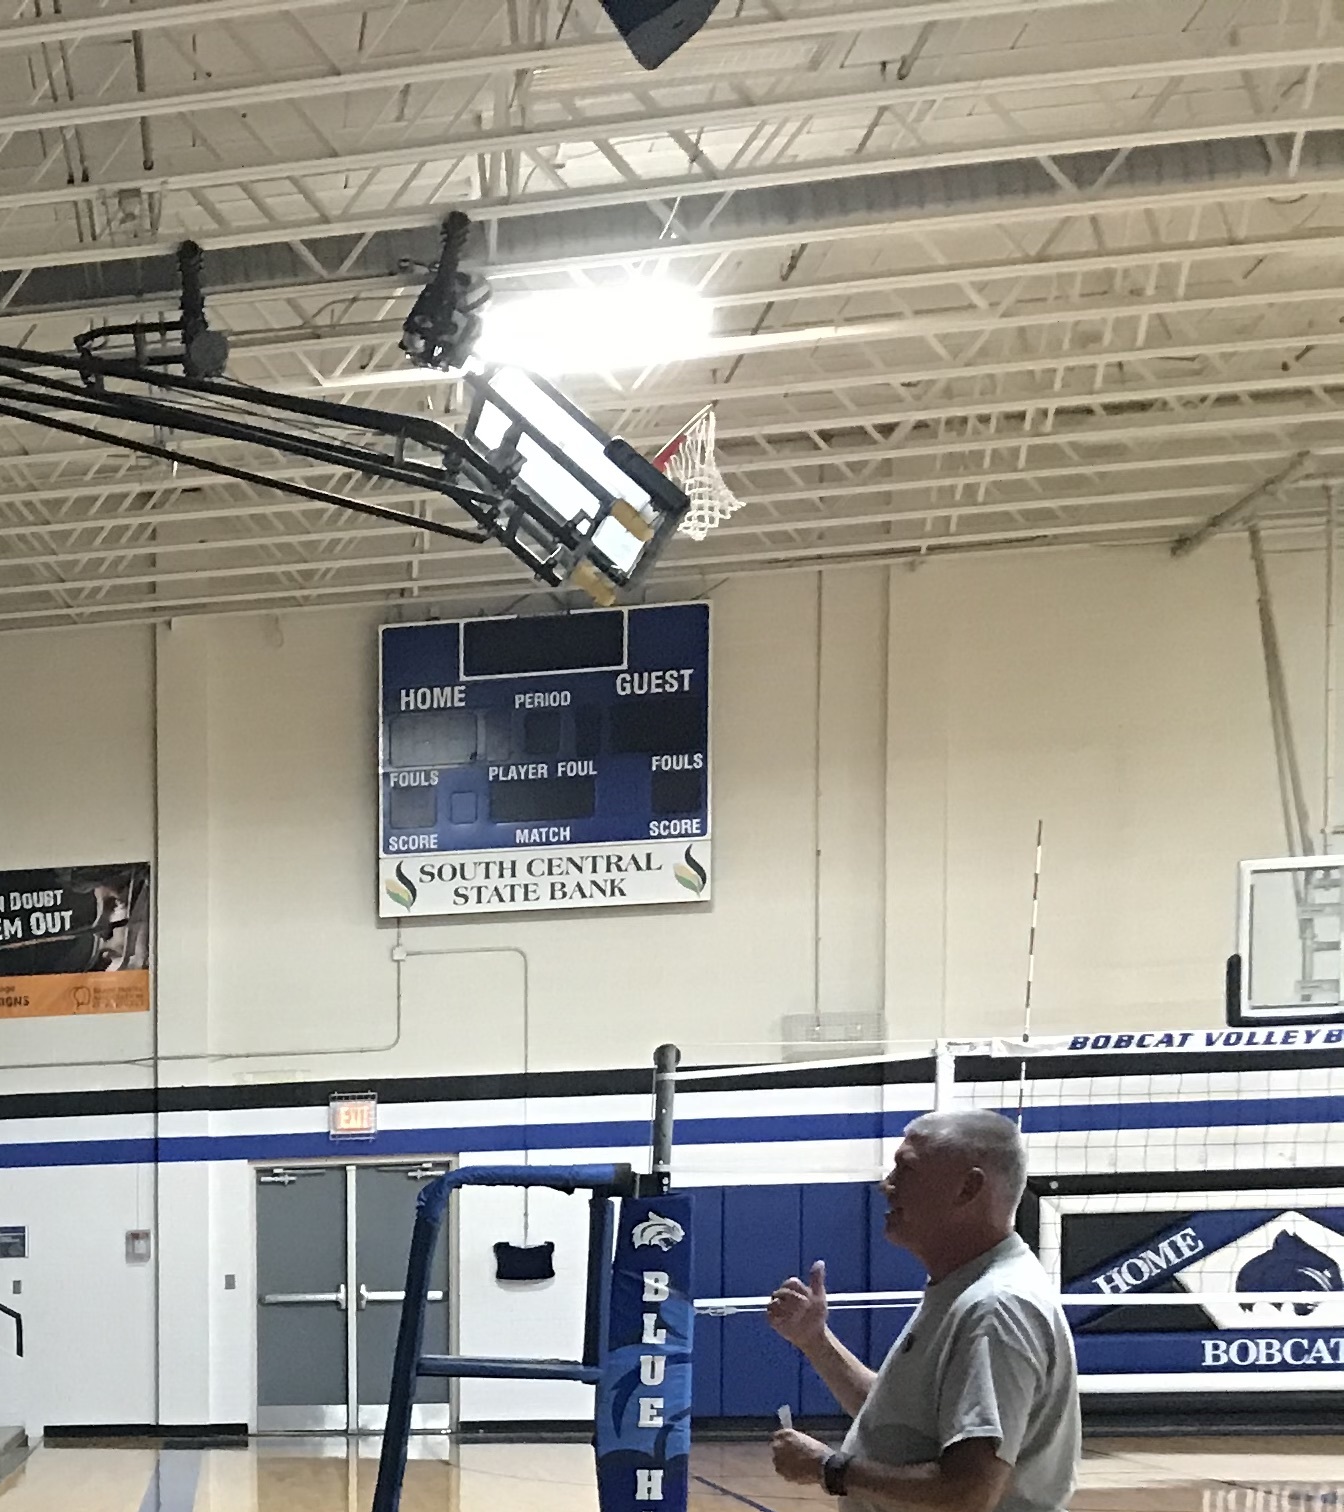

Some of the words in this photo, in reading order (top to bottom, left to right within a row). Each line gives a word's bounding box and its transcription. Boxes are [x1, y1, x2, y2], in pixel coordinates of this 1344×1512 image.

[400, 685, 466, 711] HOME
[615, 669, 694, 696] GUEST
[514, 690, 571, 709] PERIOD
[488, 763, 548, 781] PLAYER
[557, 760, 598, 778] FOUL
[651, 753, 703, 771] FOULS
[389, 770, 439, 787] FOULS
[515, 826, 571, 844] MATCH
[649, 819, 701, 836] SCORE
[388, 834, 438, 852] SCORE
[418, 858, 517, 883] SOUTH
[526, 852, 663, 877] CENTRAL
[10, 889, 63, 911] DOUBT
[452, 882, 541, 906] STATE
[549, 878, 627, 901] BANK
[29, 910, 72, 936] OUT
[1068, 1032, 1194, 1050] BOBCAT
[340, 1106, 370, 1129] EXIT
[1092, 1227, 1204, 1295] HOME
[638, 1270, 669, 1428] BLUE
